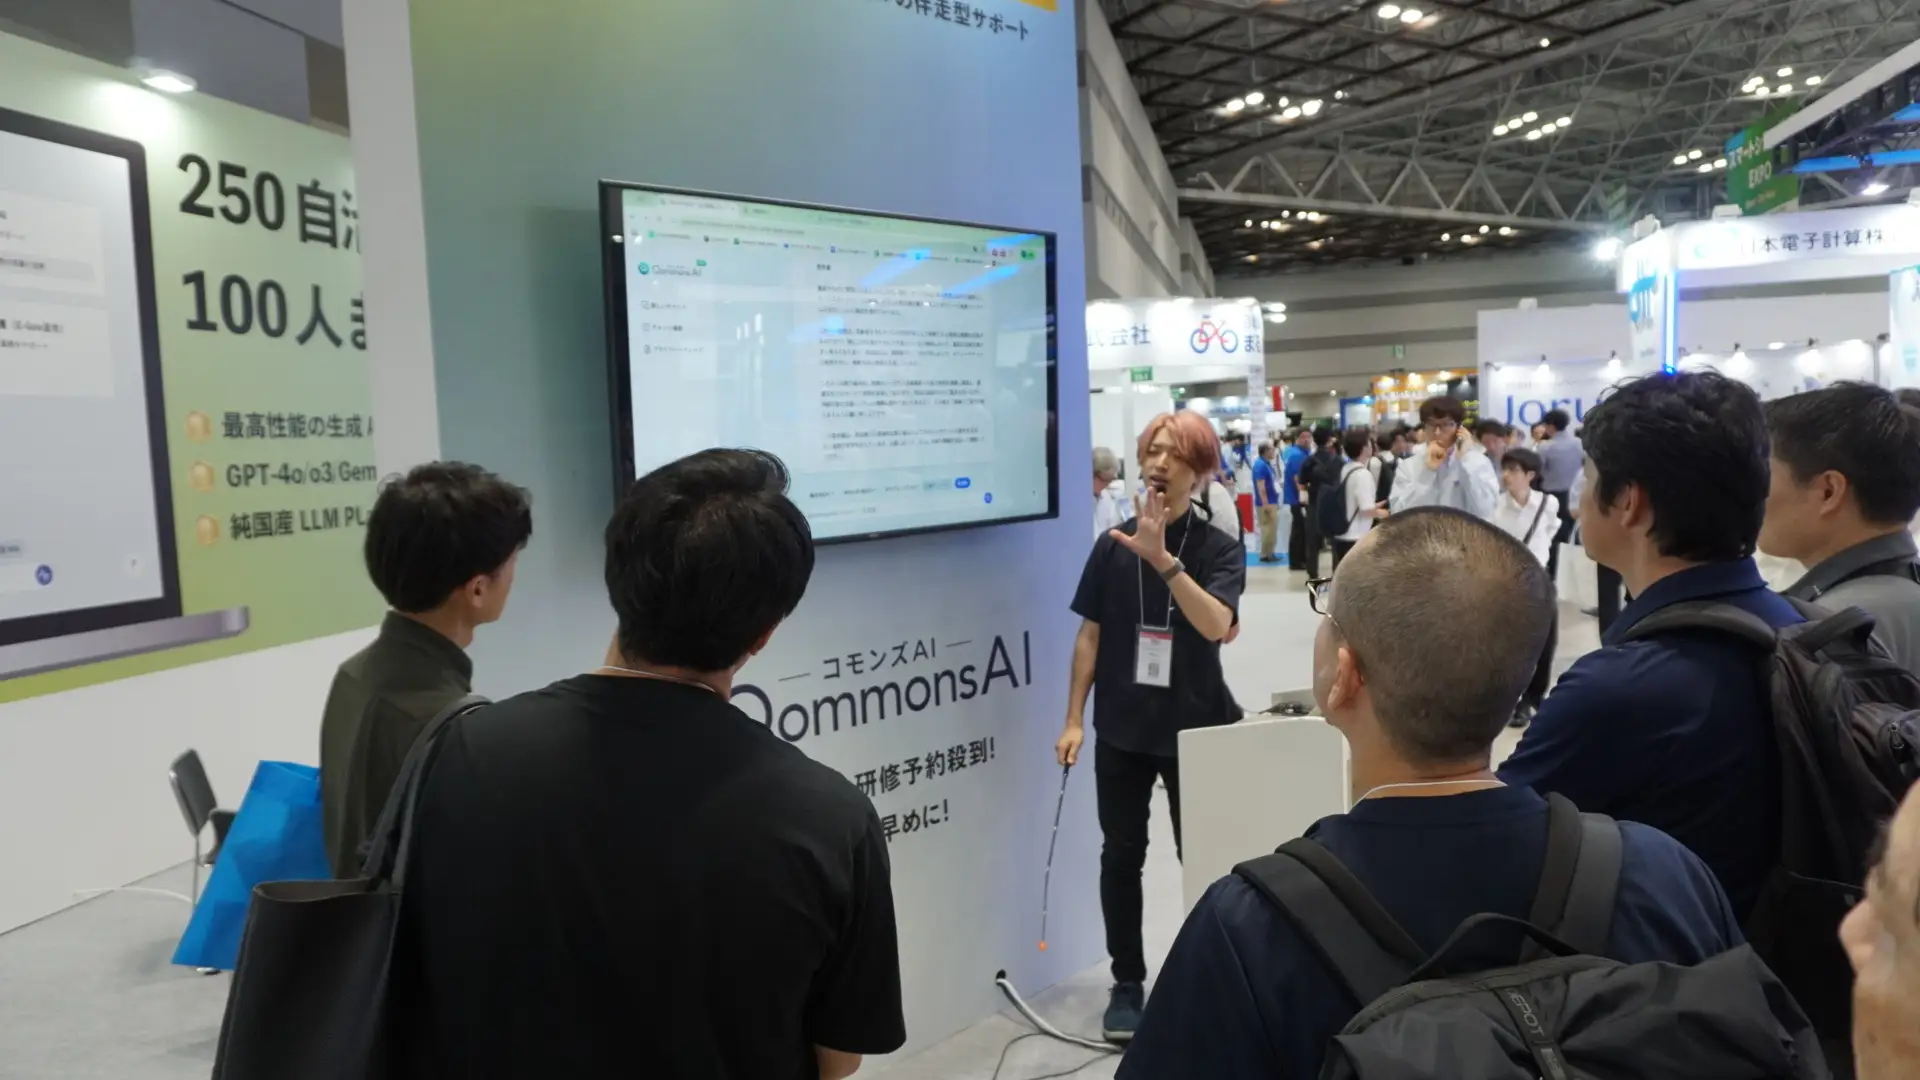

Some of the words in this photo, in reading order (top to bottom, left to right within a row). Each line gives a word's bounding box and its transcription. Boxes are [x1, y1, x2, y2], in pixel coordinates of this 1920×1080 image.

[1748, 161, 1772, 190] EXPO
[300, 507, 340, 532] LLM
[823, 637, 936, 680] コモンズAI
